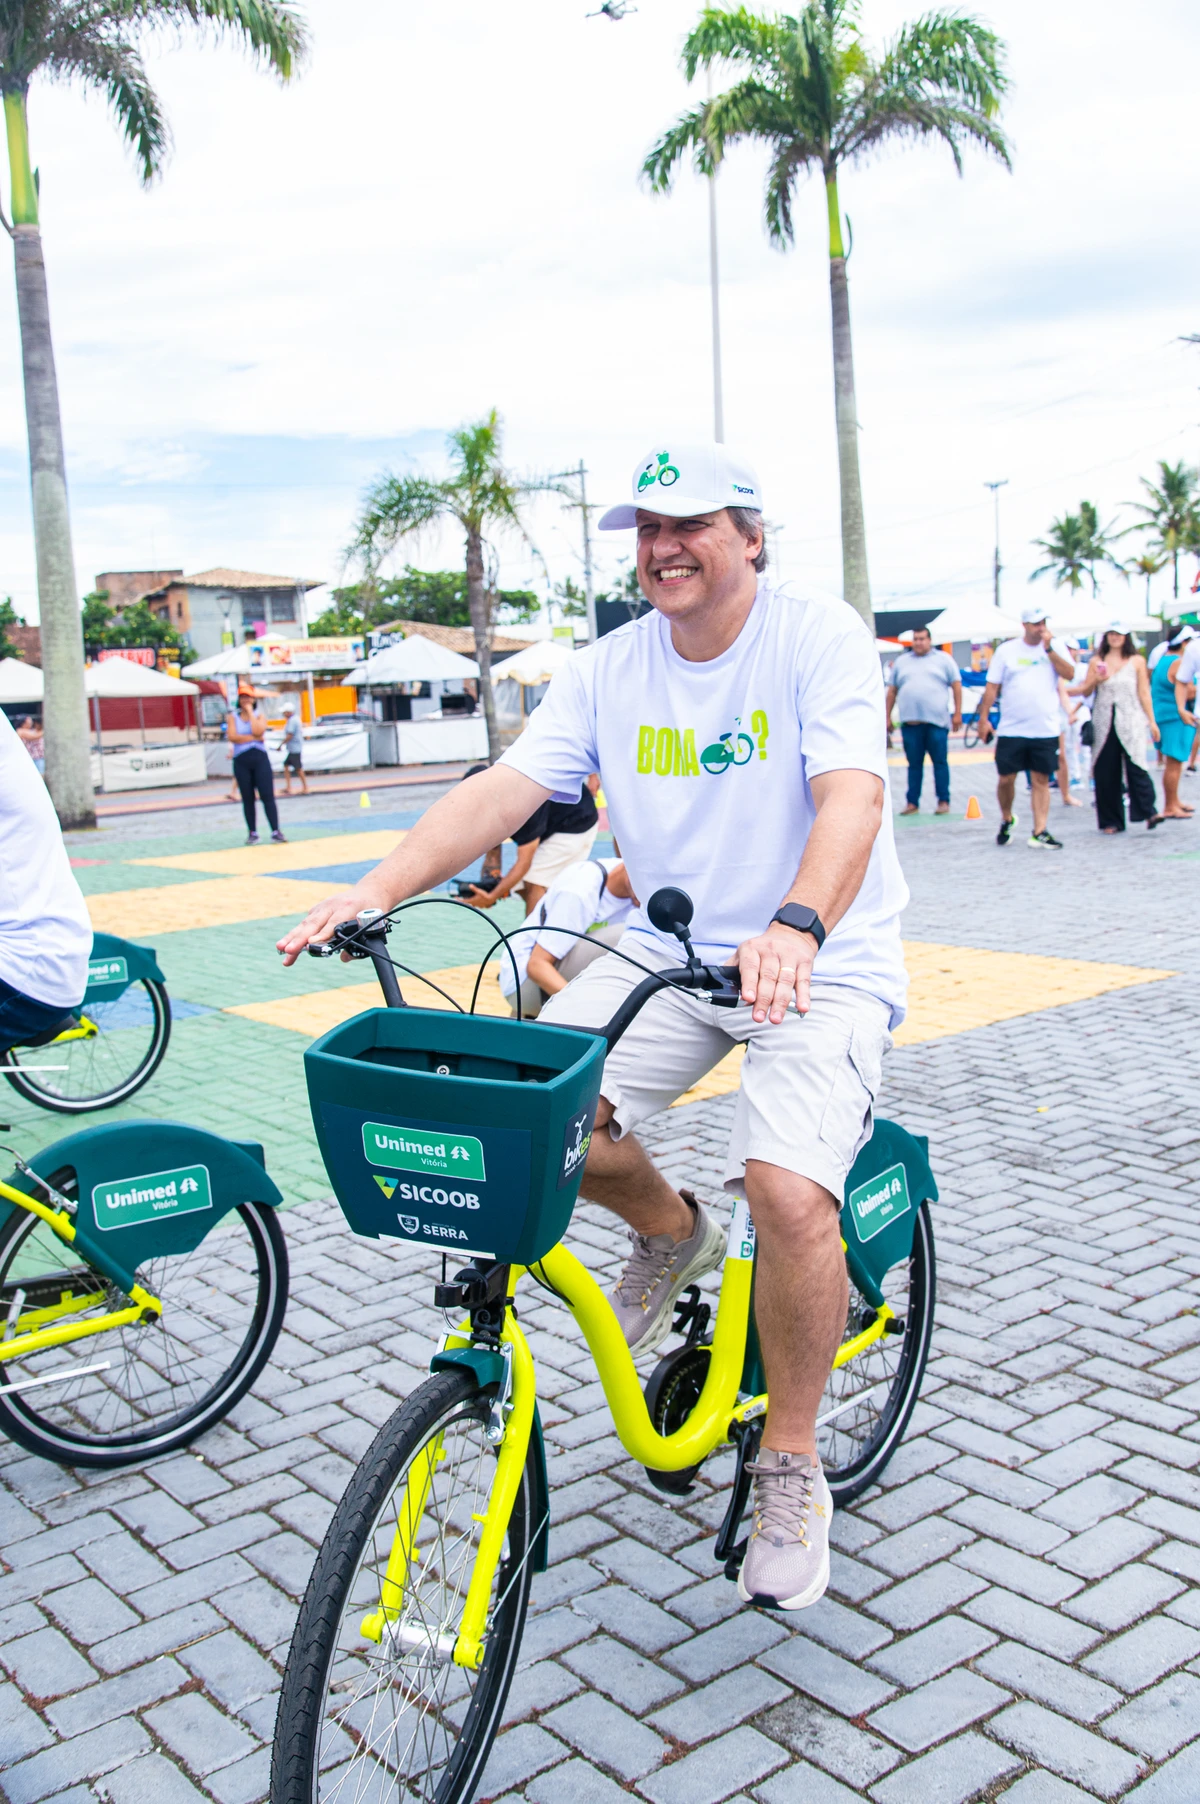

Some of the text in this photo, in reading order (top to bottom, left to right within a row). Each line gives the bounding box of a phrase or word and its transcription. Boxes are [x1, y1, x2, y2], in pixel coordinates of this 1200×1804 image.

[375, 1134, 446, 1158] Unimed
[421, 1157, 447, 1168] Vitória
[106, 1180, 177, 1209] Unimed
[152, 1199, 178, 1211] Vitória
[400, 1183, 480, 1210] SICOOB
[857, 1183, 891, 1218] Unimed
[423, 1224, 469, 1241] SERRA
